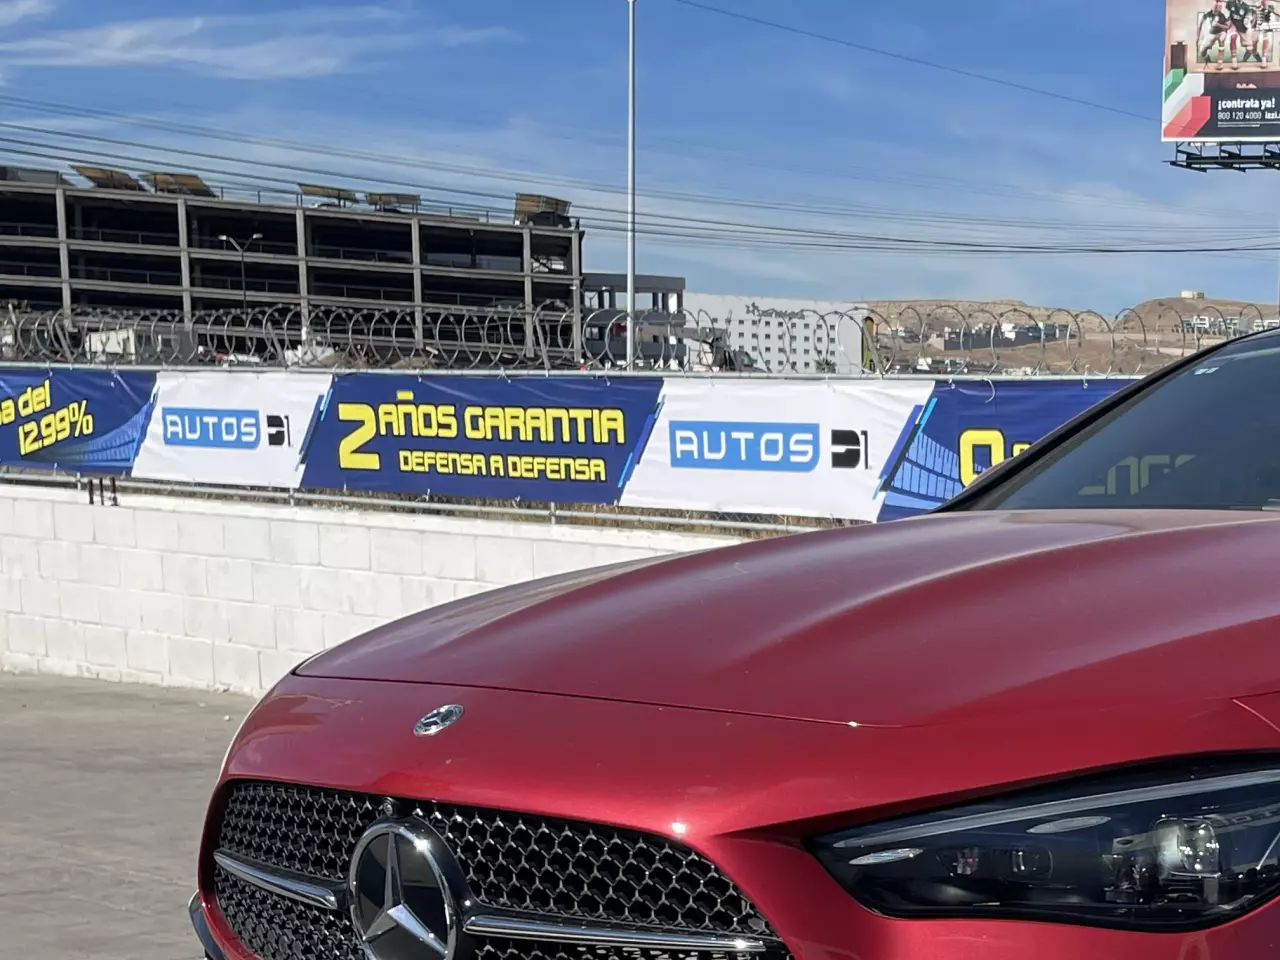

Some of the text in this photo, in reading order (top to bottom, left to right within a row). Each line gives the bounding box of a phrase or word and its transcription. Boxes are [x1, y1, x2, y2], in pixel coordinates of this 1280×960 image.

[1217, 112, 1231, 120] 800
[1232, 112, 1244, 120] 120
[1245, 111, 1262, 120] 4000
[0, 379, 51, 425] a del
[164, 414, 258, 443] AUTOS
[338, 390, 625, 470] 2 AÑOS GARANTIA
[674, 428, 814, 463] AUTOS
[399, 450, 606, 481] DEFENSA A DEFENSA
